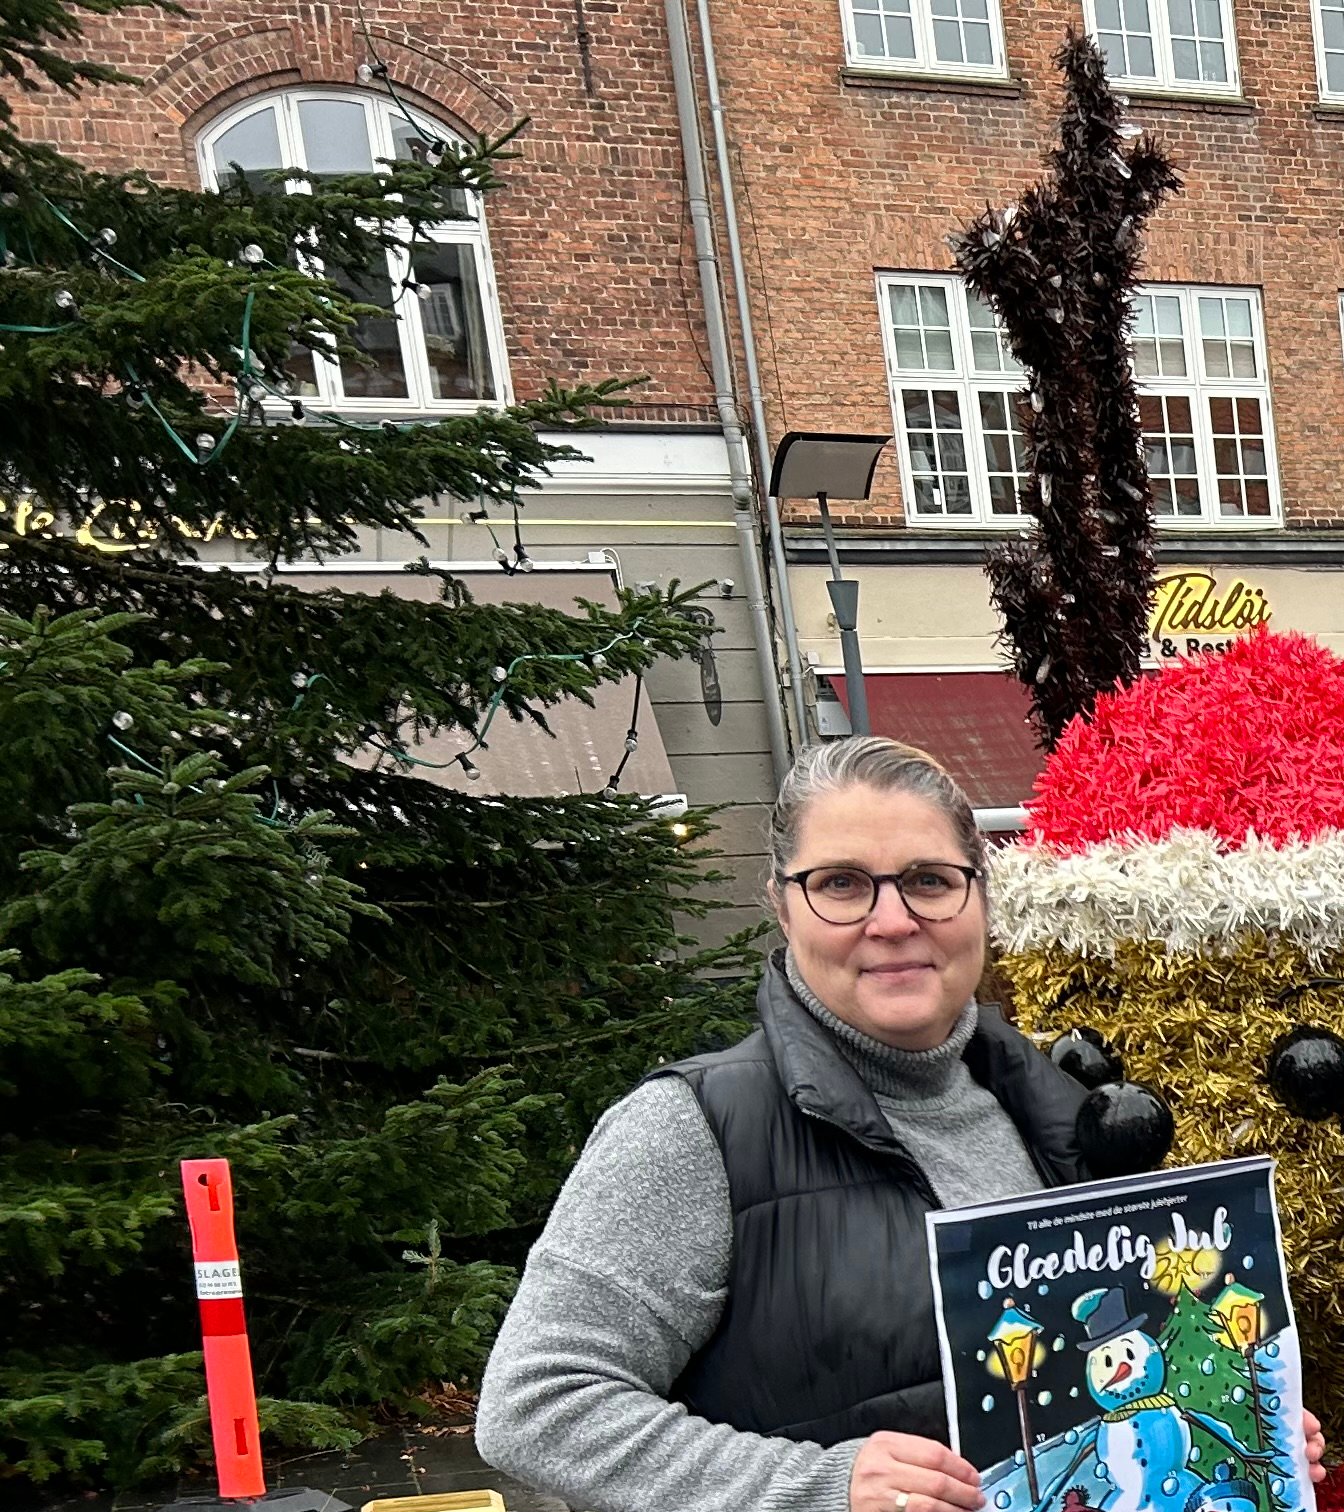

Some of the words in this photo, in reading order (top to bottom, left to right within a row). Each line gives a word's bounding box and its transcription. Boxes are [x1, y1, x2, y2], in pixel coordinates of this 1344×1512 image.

[1153, 572, 1273, 643] Tidslös
[1160, 638, 1177, 657] &
[988, 1226, 1156, 1288] Glædelig
[1167, 1206, 1231, 1252] Jul
[197, 1267, 241, 1279] SLAGE
